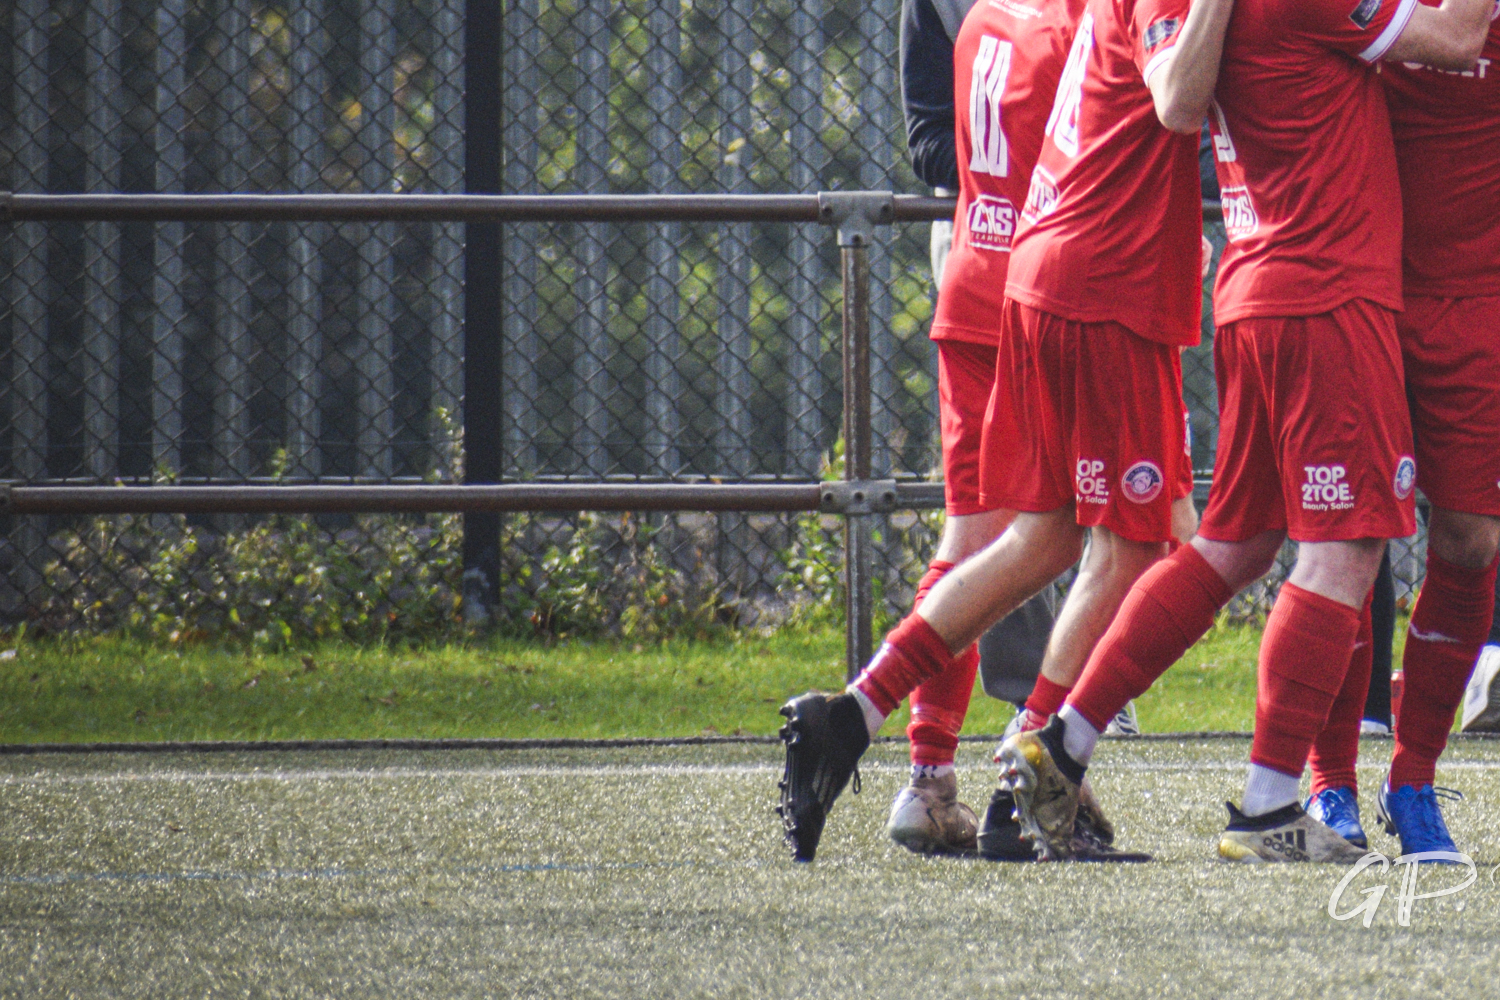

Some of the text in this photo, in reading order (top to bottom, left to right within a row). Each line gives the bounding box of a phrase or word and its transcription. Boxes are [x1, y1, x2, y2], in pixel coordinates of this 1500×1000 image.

[969, 34, 1013, 178] 11
[1077, 459, 1104, 477] OP
[1304, 466, 1346, 484] TOP
[1076, 476, 1109, 496] OE.
[1302, 483, 1355, 501] 2TOE.
[1302, 501, 1355, 511] Beauty Salon
